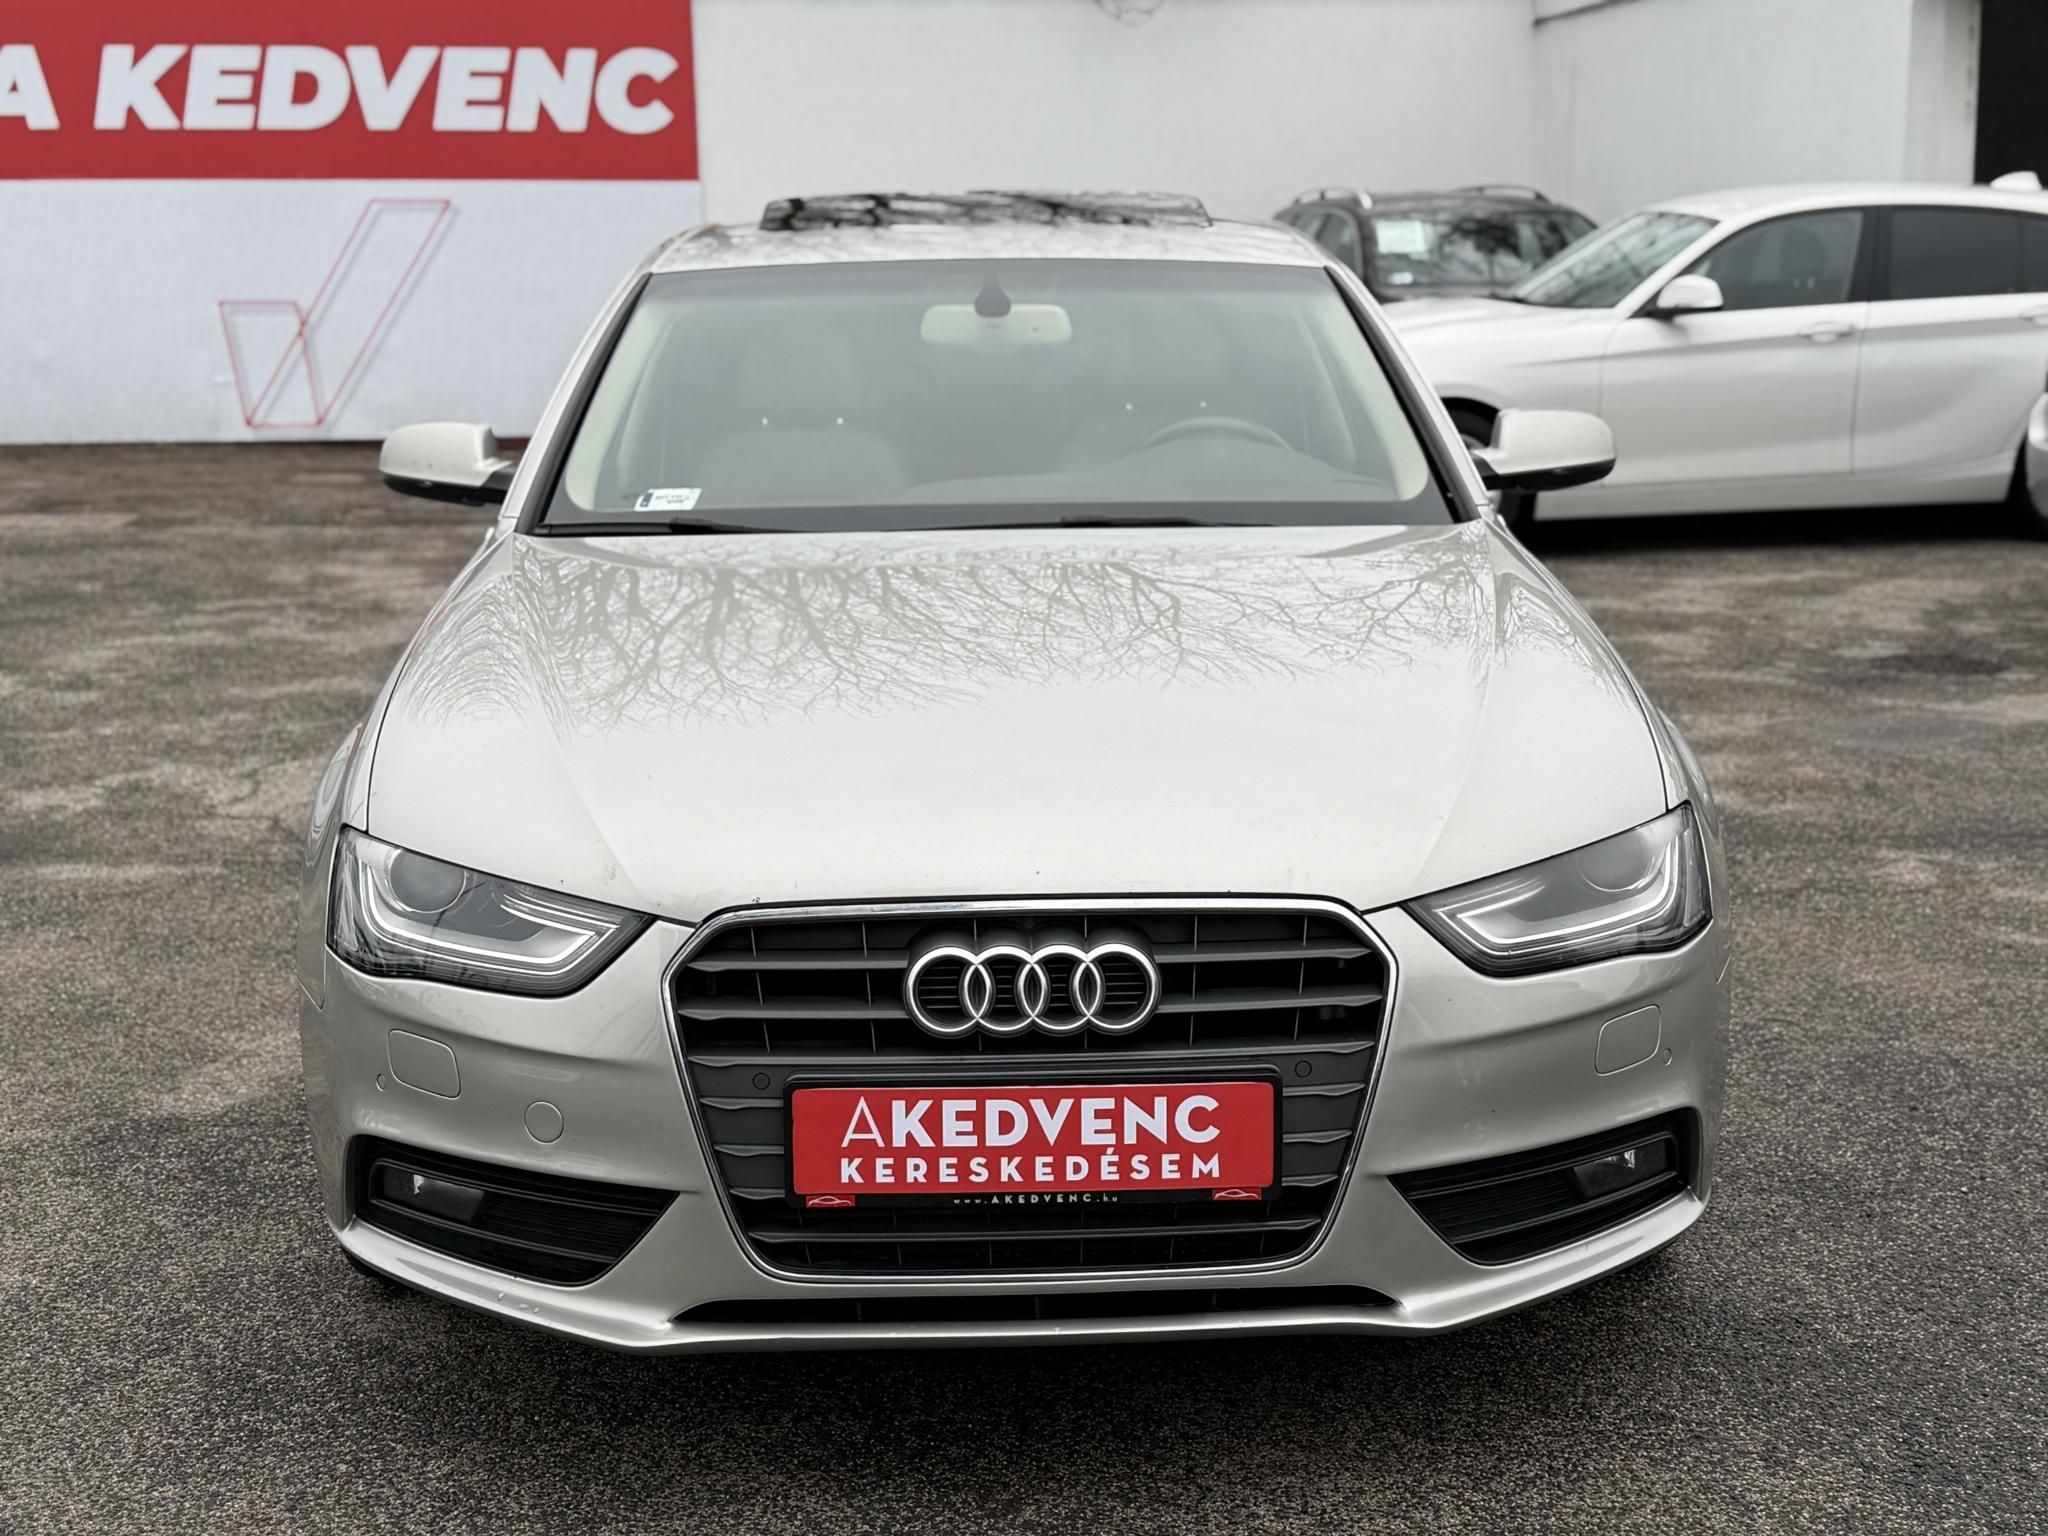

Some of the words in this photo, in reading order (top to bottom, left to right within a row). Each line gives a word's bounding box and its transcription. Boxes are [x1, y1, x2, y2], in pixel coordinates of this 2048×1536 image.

[0, 44, 60, 130] A
[93, 43, 679, 135] KEDVENC
[840, 1148, 1221, 1184] KERESKEDÉSEM
[953, 1192, 1119, 1205] www.AKEDVENC.hu
